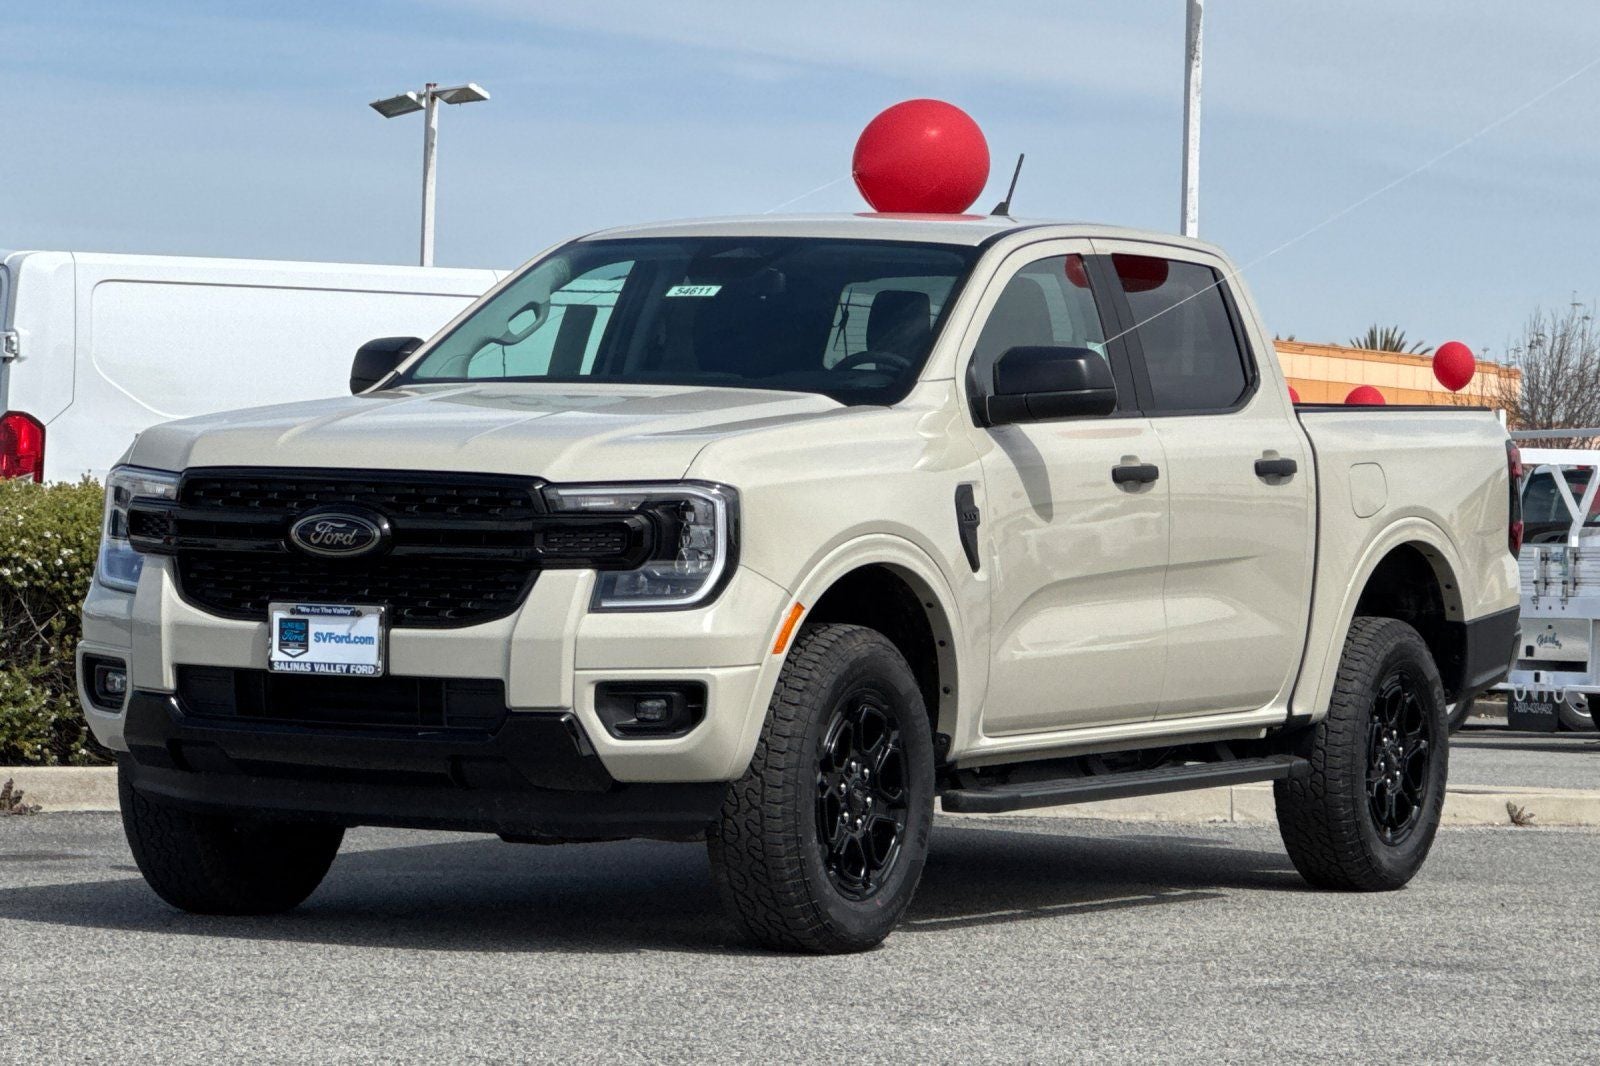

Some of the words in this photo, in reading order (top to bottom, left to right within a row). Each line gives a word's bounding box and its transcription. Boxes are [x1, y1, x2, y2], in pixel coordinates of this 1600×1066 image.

[675, 287, 712, 295] 54611
[310, 521, 358, 545] Ford
[314, 632, 374, 644] SVFord.com
[273, 662, 311, 672] SALINAS
[314, 663, 348, 673] VALLEY
[350, 665, 375, 675] FORD
